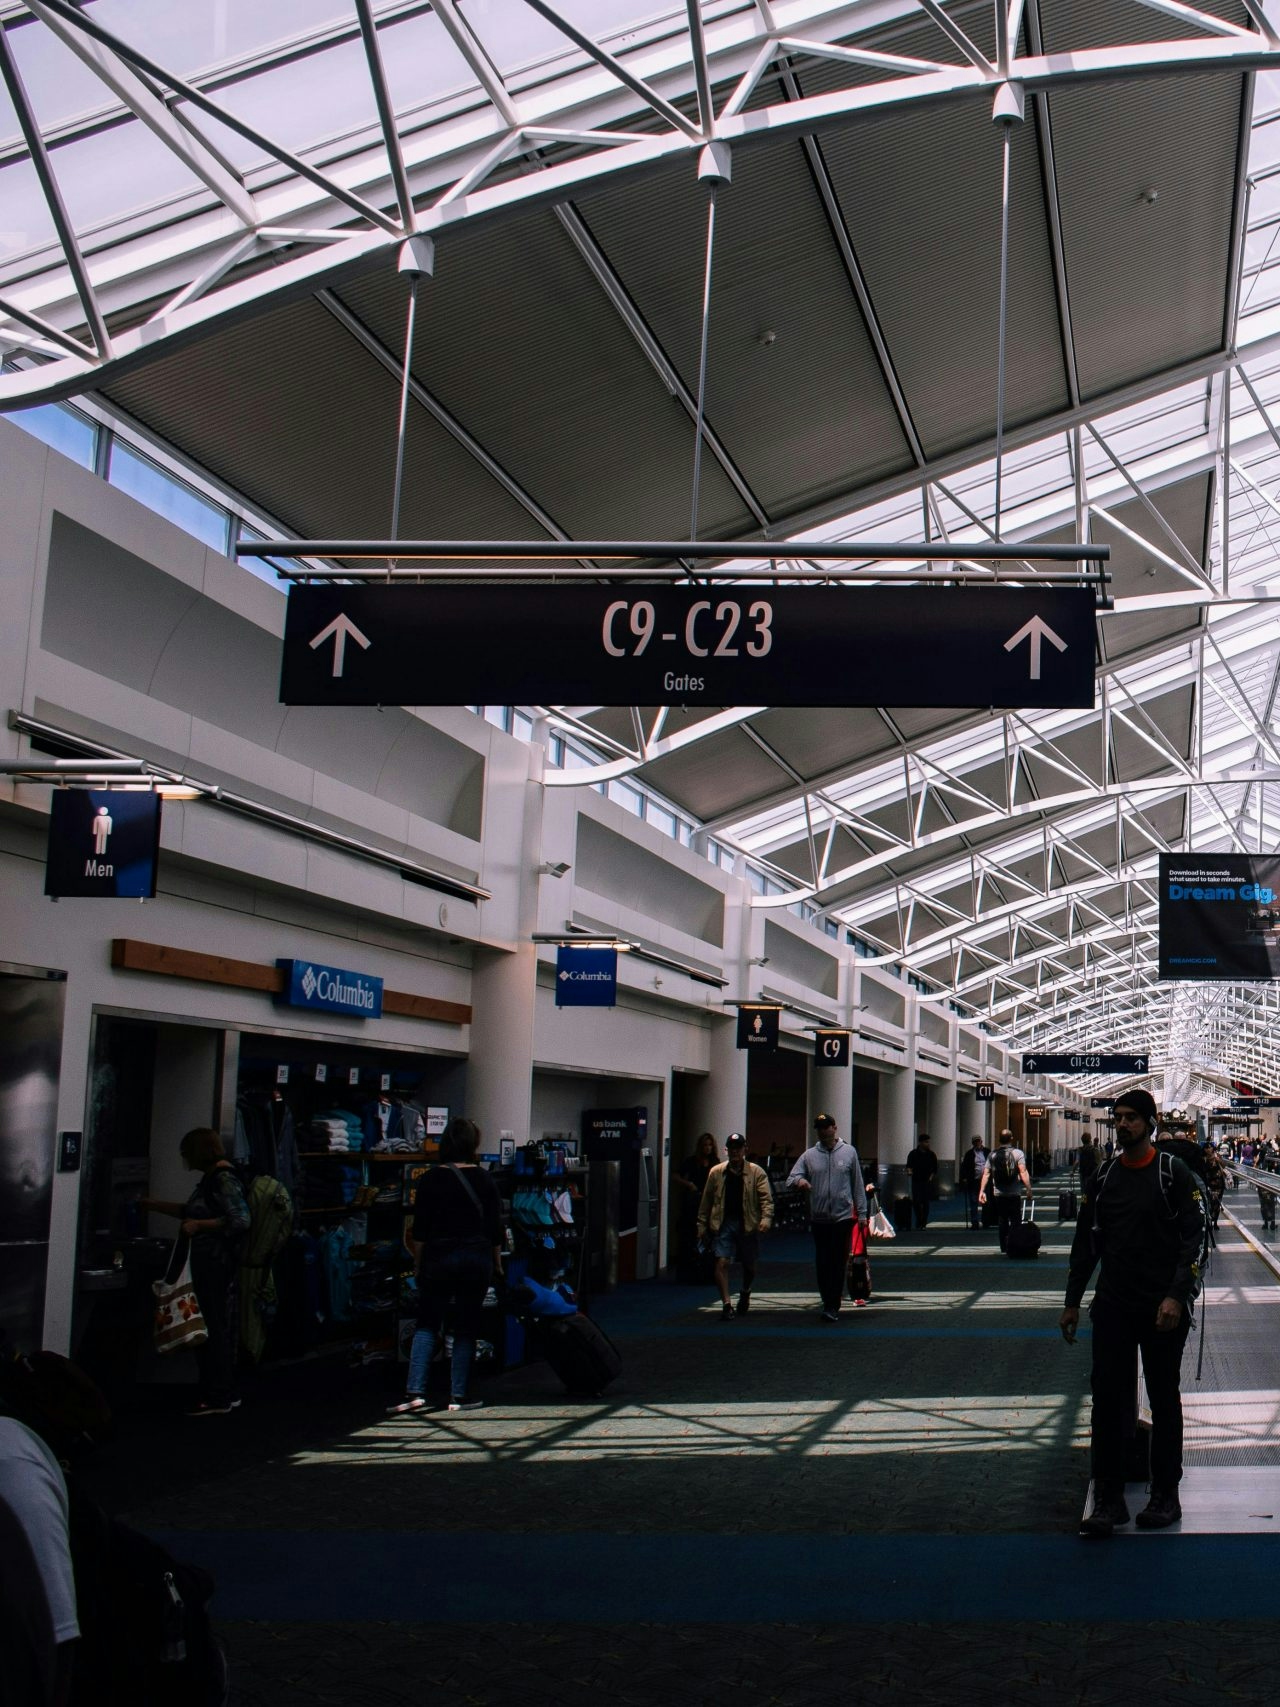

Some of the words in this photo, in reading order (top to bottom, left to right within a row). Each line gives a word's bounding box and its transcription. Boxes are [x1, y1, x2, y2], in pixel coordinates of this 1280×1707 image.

[602, 601, 773, 657] C9-C23
[664, 671, 705, 691] Gates
[85, 859, 114, 877] Men
[1169, 884, 1236, 901] Dream
[1239, 883, 1278, 904] Gig.
[569, 971, 612, 981] Columbia
[317, 971, 375, 1009] Columbia
[747, 1034, 768, 1042] Women
[823, 1039, 841, 1058] C9
[1070, 1057, 1101, 1067] C11-C23
[979, 1086, 992, 1097] C11
[600, 1130, 621, 1138] ATM
